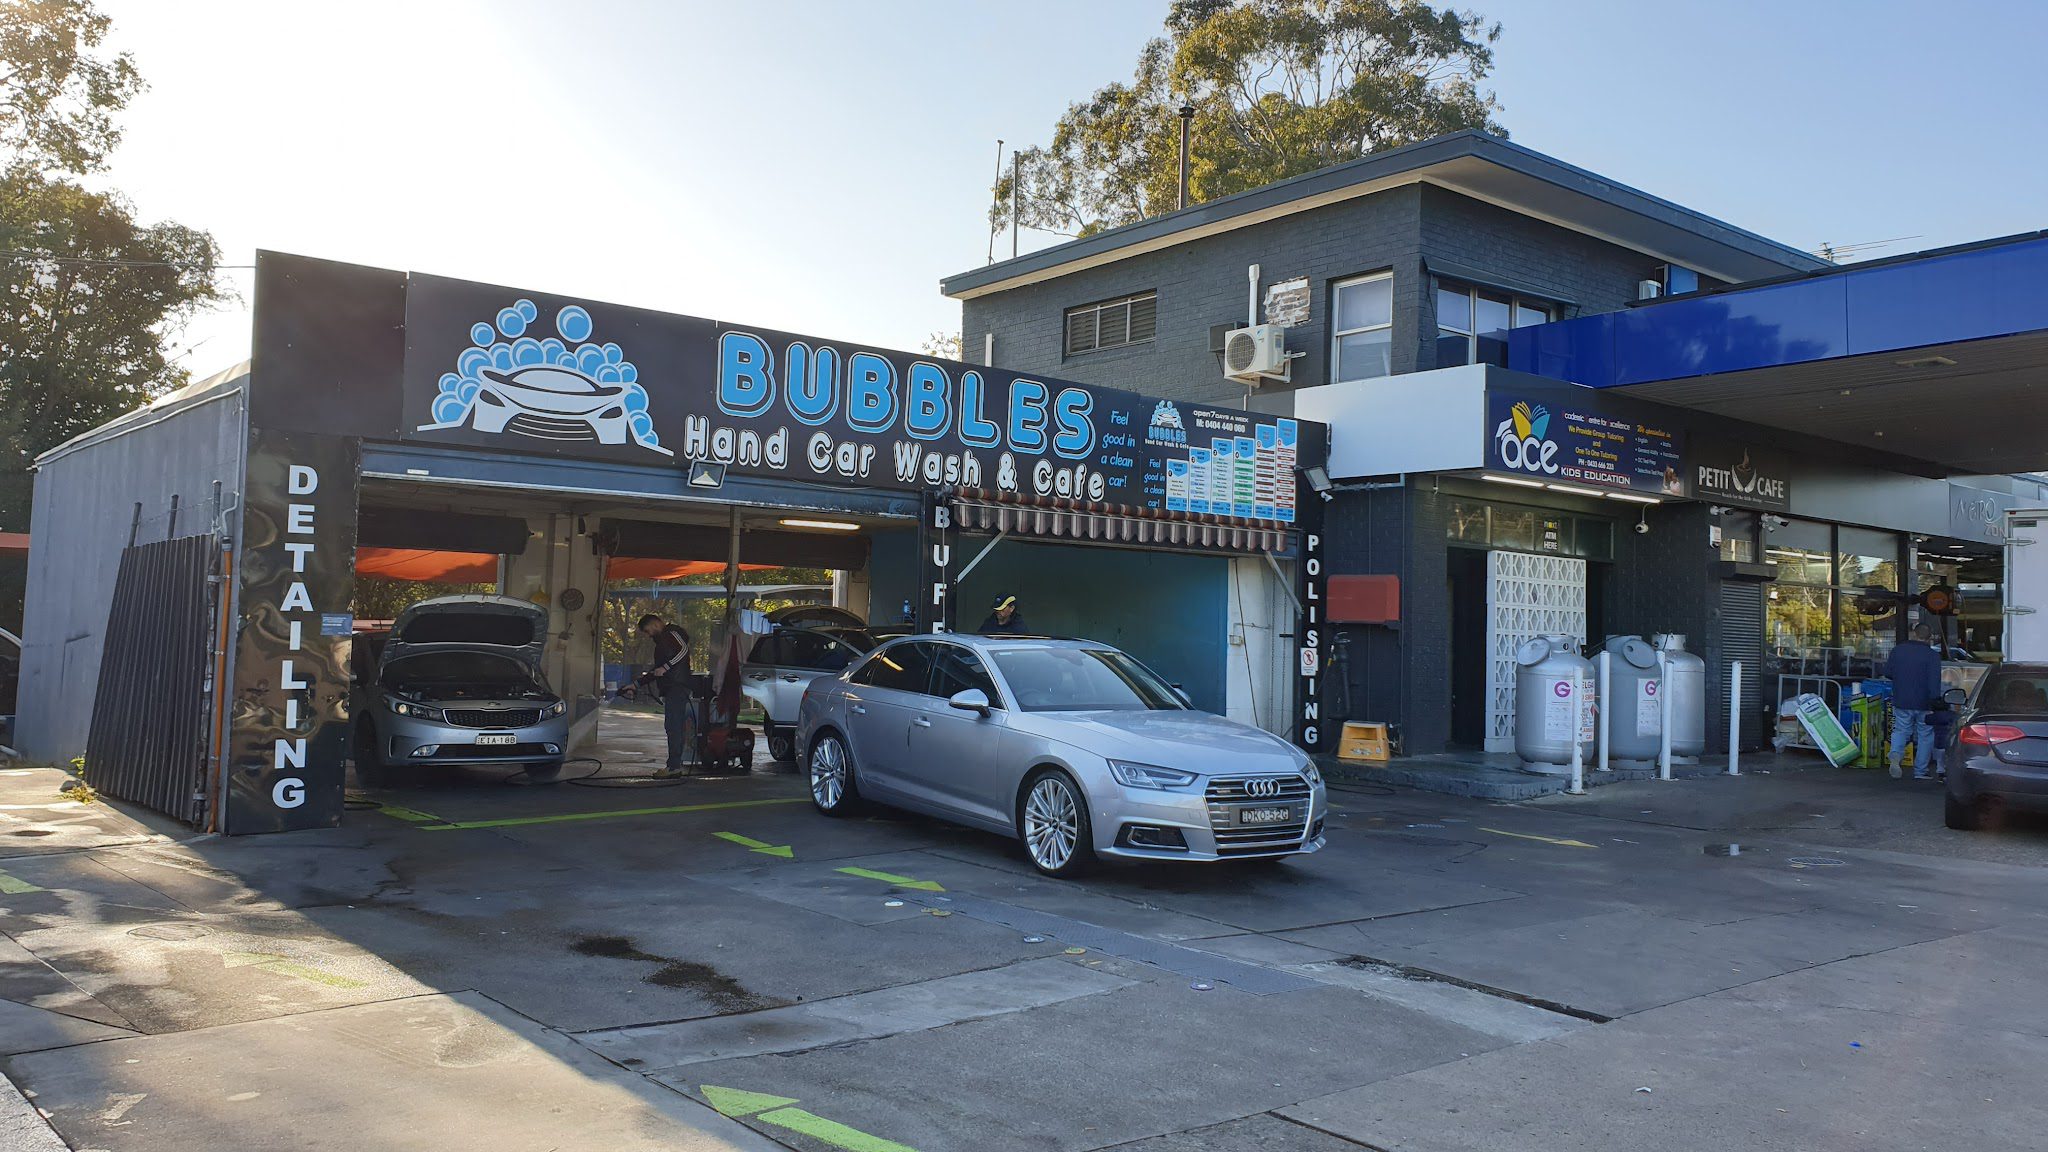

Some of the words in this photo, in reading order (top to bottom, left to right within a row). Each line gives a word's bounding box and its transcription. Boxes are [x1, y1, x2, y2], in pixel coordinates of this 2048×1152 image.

[717, 331, 1095, 460] BUBBLES
[1111, 410, 1129, 426] Feel
[1205, 419, 1221, 430] 0404
[1221, 422, 1233, 432] 440
[1102, 431, 1125, 449] good
[1127, 434, 1136, 448] in
[1144, 438, 1155, 446] Hand
[1148, 426, 1187, 443] BUBBLES
[1568, 425, 1576, 433] We
[1576, 426, 1593, 436] Provide
[1592, 429, 1605, 439] Group
[1606, 431, 1625, 443] Tutoring
[684, 414, 789, 470] Hand
[807, 431, 875, 478] Car
[894, 439, 981, 489] Wash
[997, 451, 1018, 493] &
[1033, 458, 1104, 502] Cafe
[1100, 454, 1108, 465] a
[1109, 451, 1133, 468] clean
[1501, 432, 1559, 474] ace
[1575, 446, 1585, 455] One
[1585, 448, 1591, 456] To
[1590, 449, 1600, 457] One
[1600, 450, 1618, 462] Tutoring
[1149, 458, 1161, 468] Feel
[1108, 475, 1128, 488] car!
[1143, 472, 1159, 484] good
[1159, 473, 1165, 482] in
[1561, 466, 1581, 478] KIDS
[1584, 470, 1631, 485] EDUCATION
[1699, 465, 1731, 490] PETIT
[1757, 477, 1784, 499] CAFE
[1149, 484, 1165, 495] clean
[1544, 531, 1557, 540] ATM
[1543, 541, 1558, 550] HERE
[272, 465, 318, 809] DETAILING
[1304, 534, 1320, 745] POLISING
